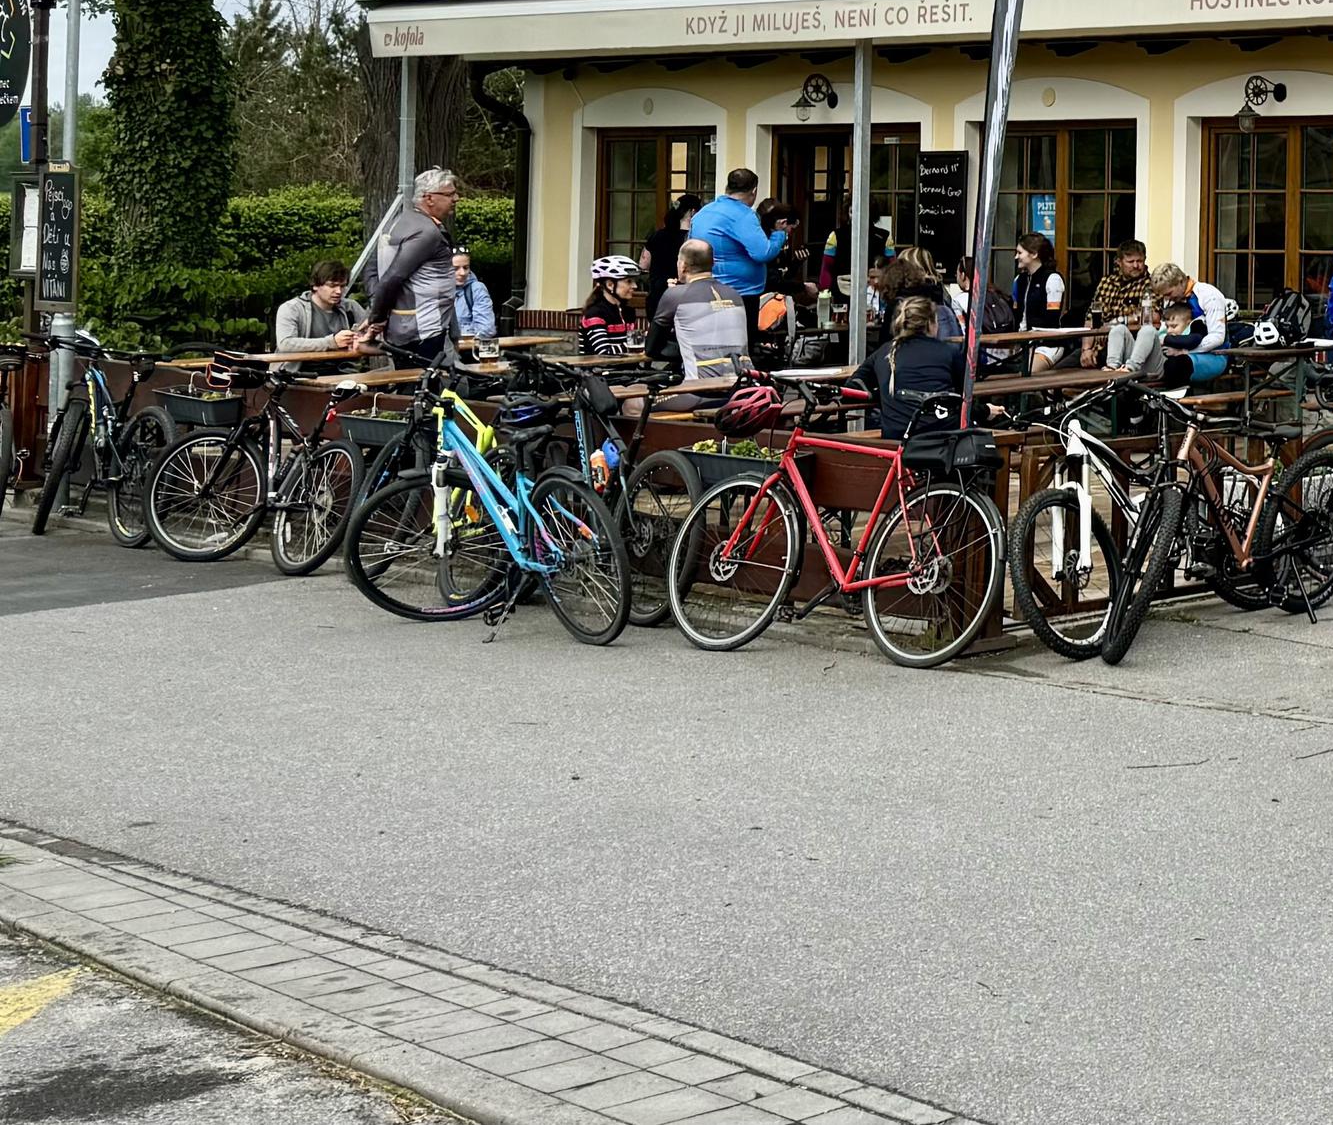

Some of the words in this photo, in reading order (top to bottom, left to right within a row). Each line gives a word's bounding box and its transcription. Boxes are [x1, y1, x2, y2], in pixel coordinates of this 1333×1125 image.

[686, 10, 728, 36] KDYŽ
[733, 14, 745, 37] JI
[752, 5, 826, 34] MILUJEŠ,
[834, 2, 877, 28] NENÍ
[884, 6, 909, 26] CO
[393, 26, 424, 52] kofola
